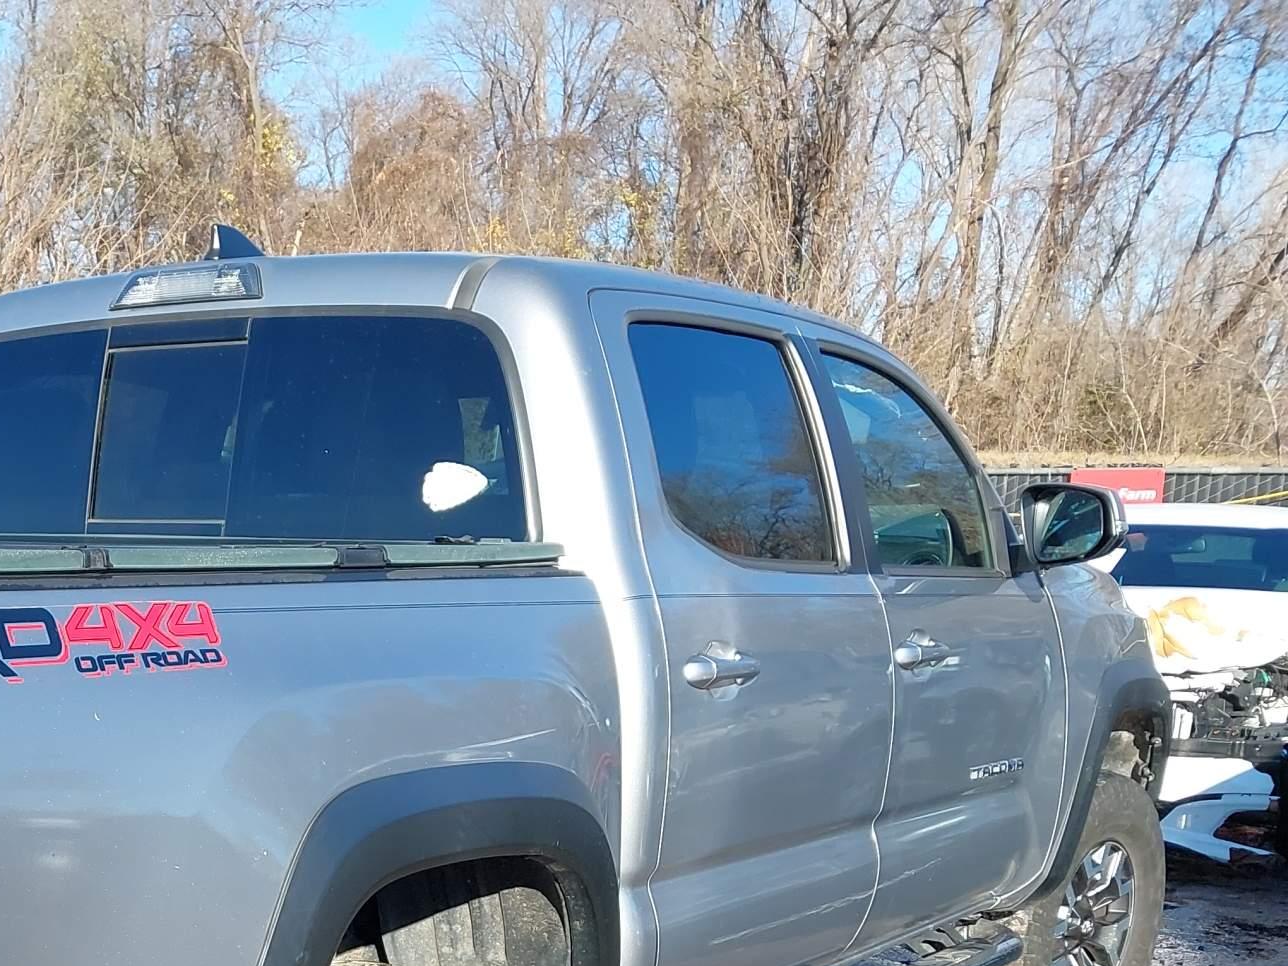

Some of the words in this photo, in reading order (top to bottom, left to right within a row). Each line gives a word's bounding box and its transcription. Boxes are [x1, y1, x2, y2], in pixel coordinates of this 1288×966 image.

[64, 601, 221, 651] 4X4
[75, 652, 139, 678] OFF
[141, 648, 228, 672] ROAD
